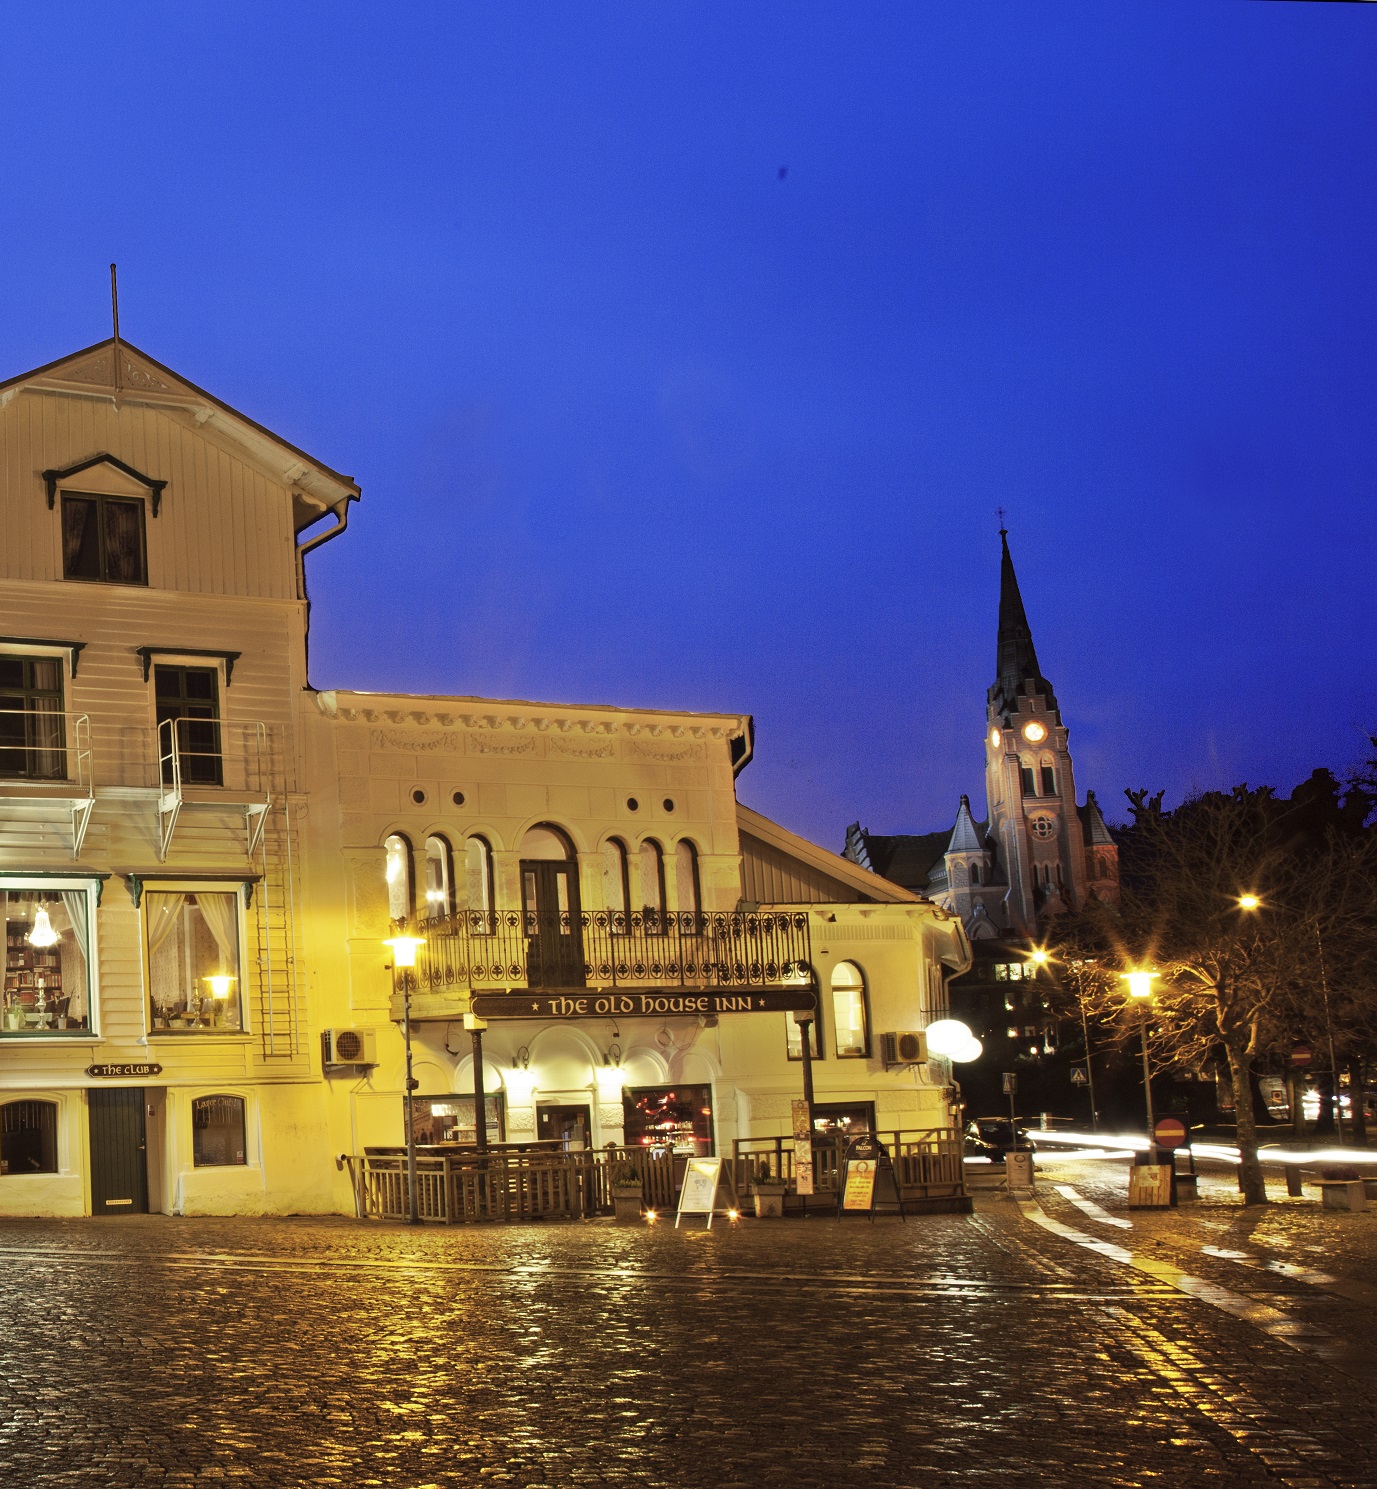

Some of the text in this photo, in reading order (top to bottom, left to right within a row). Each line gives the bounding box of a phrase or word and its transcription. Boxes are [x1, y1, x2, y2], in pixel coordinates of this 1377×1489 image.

[548, 995, 752, 1016] THE OLD HOUSE INN
